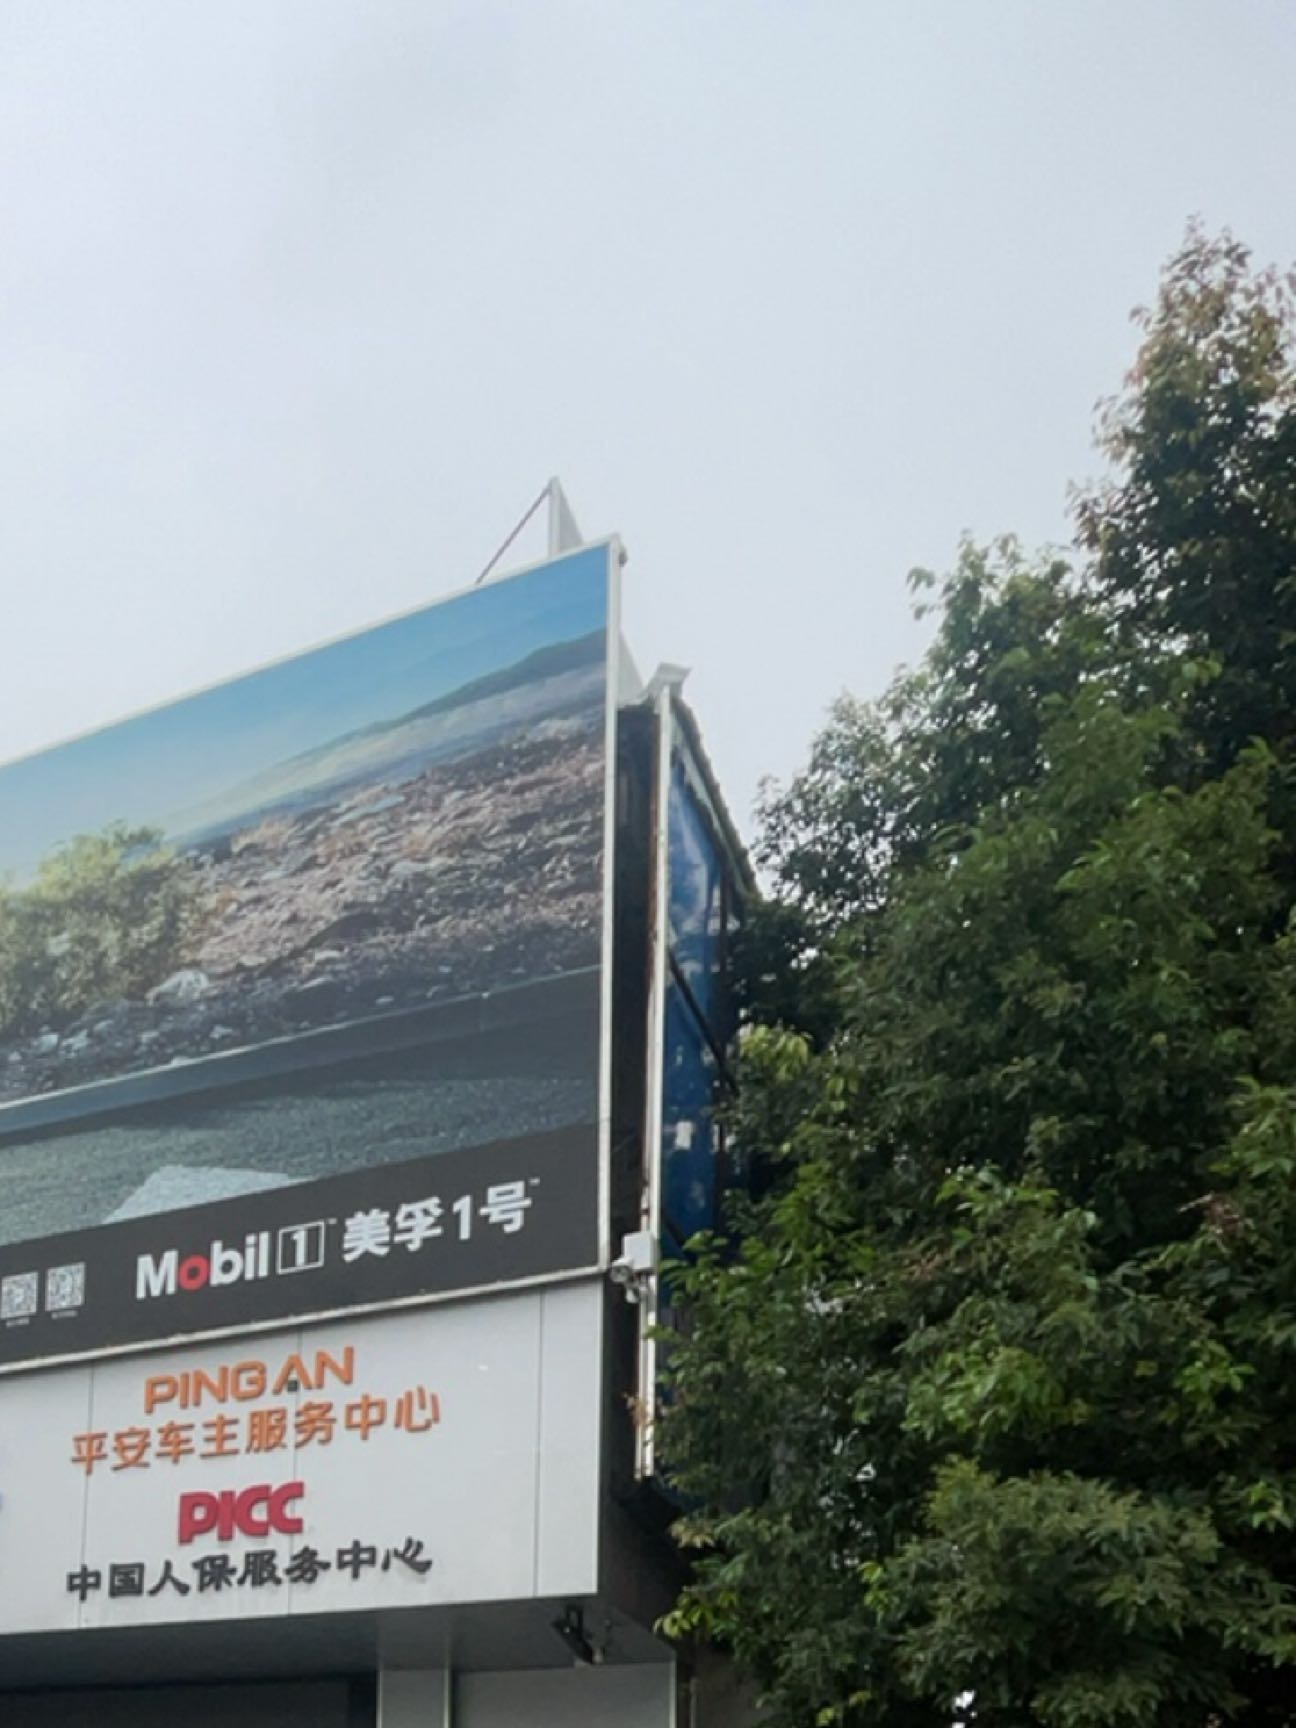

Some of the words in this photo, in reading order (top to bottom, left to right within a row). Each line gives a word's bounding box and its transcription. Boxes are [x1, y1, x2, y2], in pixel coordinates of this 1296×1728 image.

[136, 1231, 272, 1300] Mobil
[342, 1180, 532, 1263] 美孚1号
[70, 1385, 441, 1476] 平安车主服务中心
[178, 1481, 305, 1546] PICC
[65, 1536, 434, 1602] 中国人保服务中心
